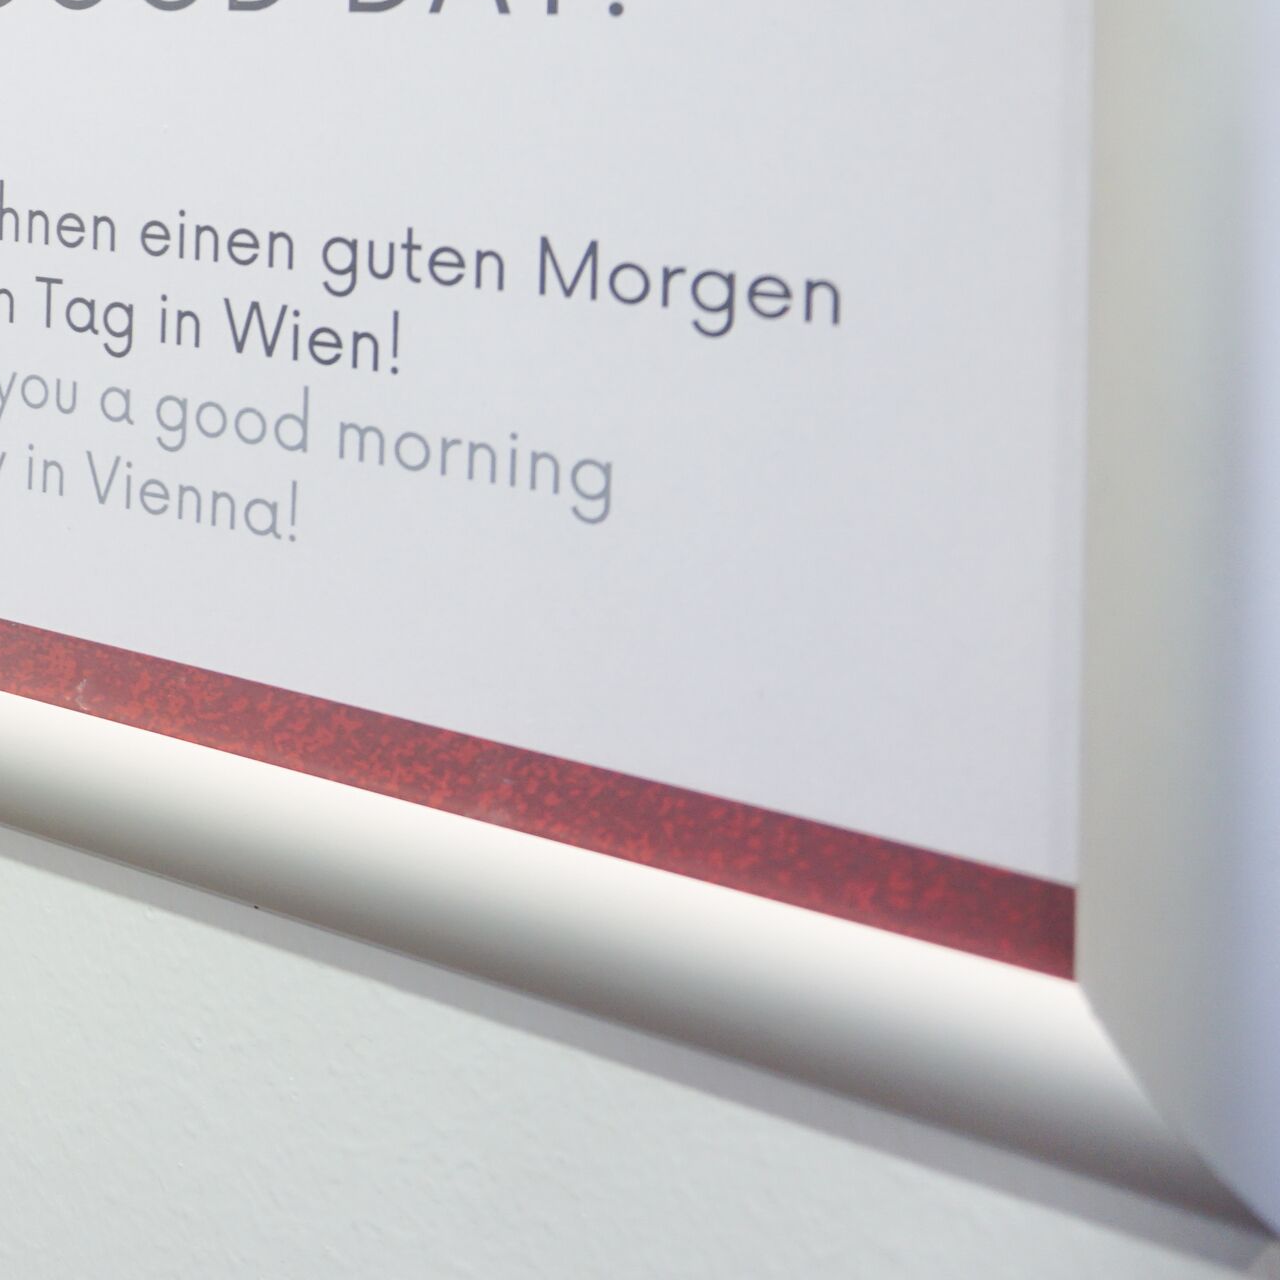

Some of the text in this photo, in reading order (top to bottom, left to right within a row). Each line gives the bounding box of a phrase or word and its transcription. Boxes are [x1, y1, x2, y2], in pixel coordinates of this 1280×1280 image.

[35, 276, 134, 358] Tag
[160, 294, 201, 348] in
[224, 298, 400, 375] Wien!
[140, 210, 294, 270] einen
[322, 227, 505, 297] guten
[539, 236, 840, 338] Morgen
[26, 444, 64, 496] in
[86, 451, 297, 542] Vienna!
[100, 386, 134, 425] a
[156, 386, 309, 453] good
[339, 420, 613, 525] morning
